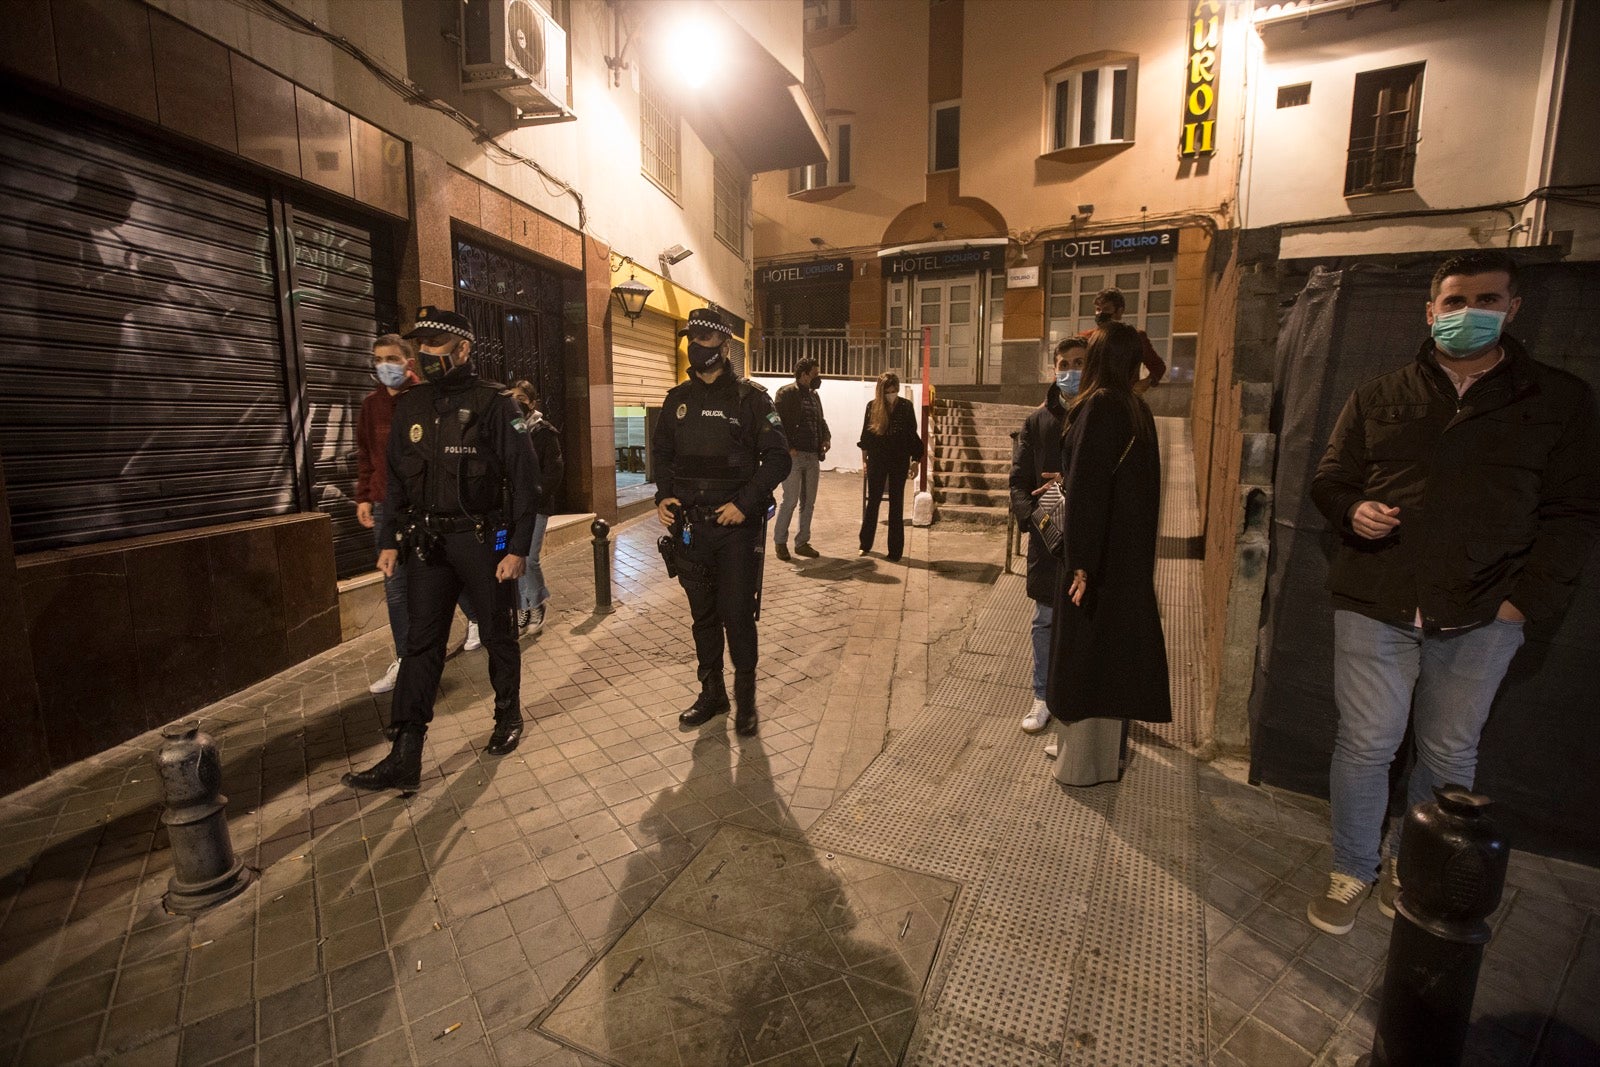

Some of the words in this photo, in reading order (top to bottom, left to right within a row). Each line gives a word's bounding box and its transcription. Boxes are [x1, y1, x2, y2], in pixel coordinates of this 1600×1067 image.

[1052, 240, 1111, 258] HOTEL
[1161, 234, 1170, 245] 2
[893, 256, 943, 273] HOTEL
[983, 251, 990, 261] 2
[762, 267, 804, 283] HOTEL
[837, 263, 844, 271] 2
[445, 446, 477, 454] POLICIA
